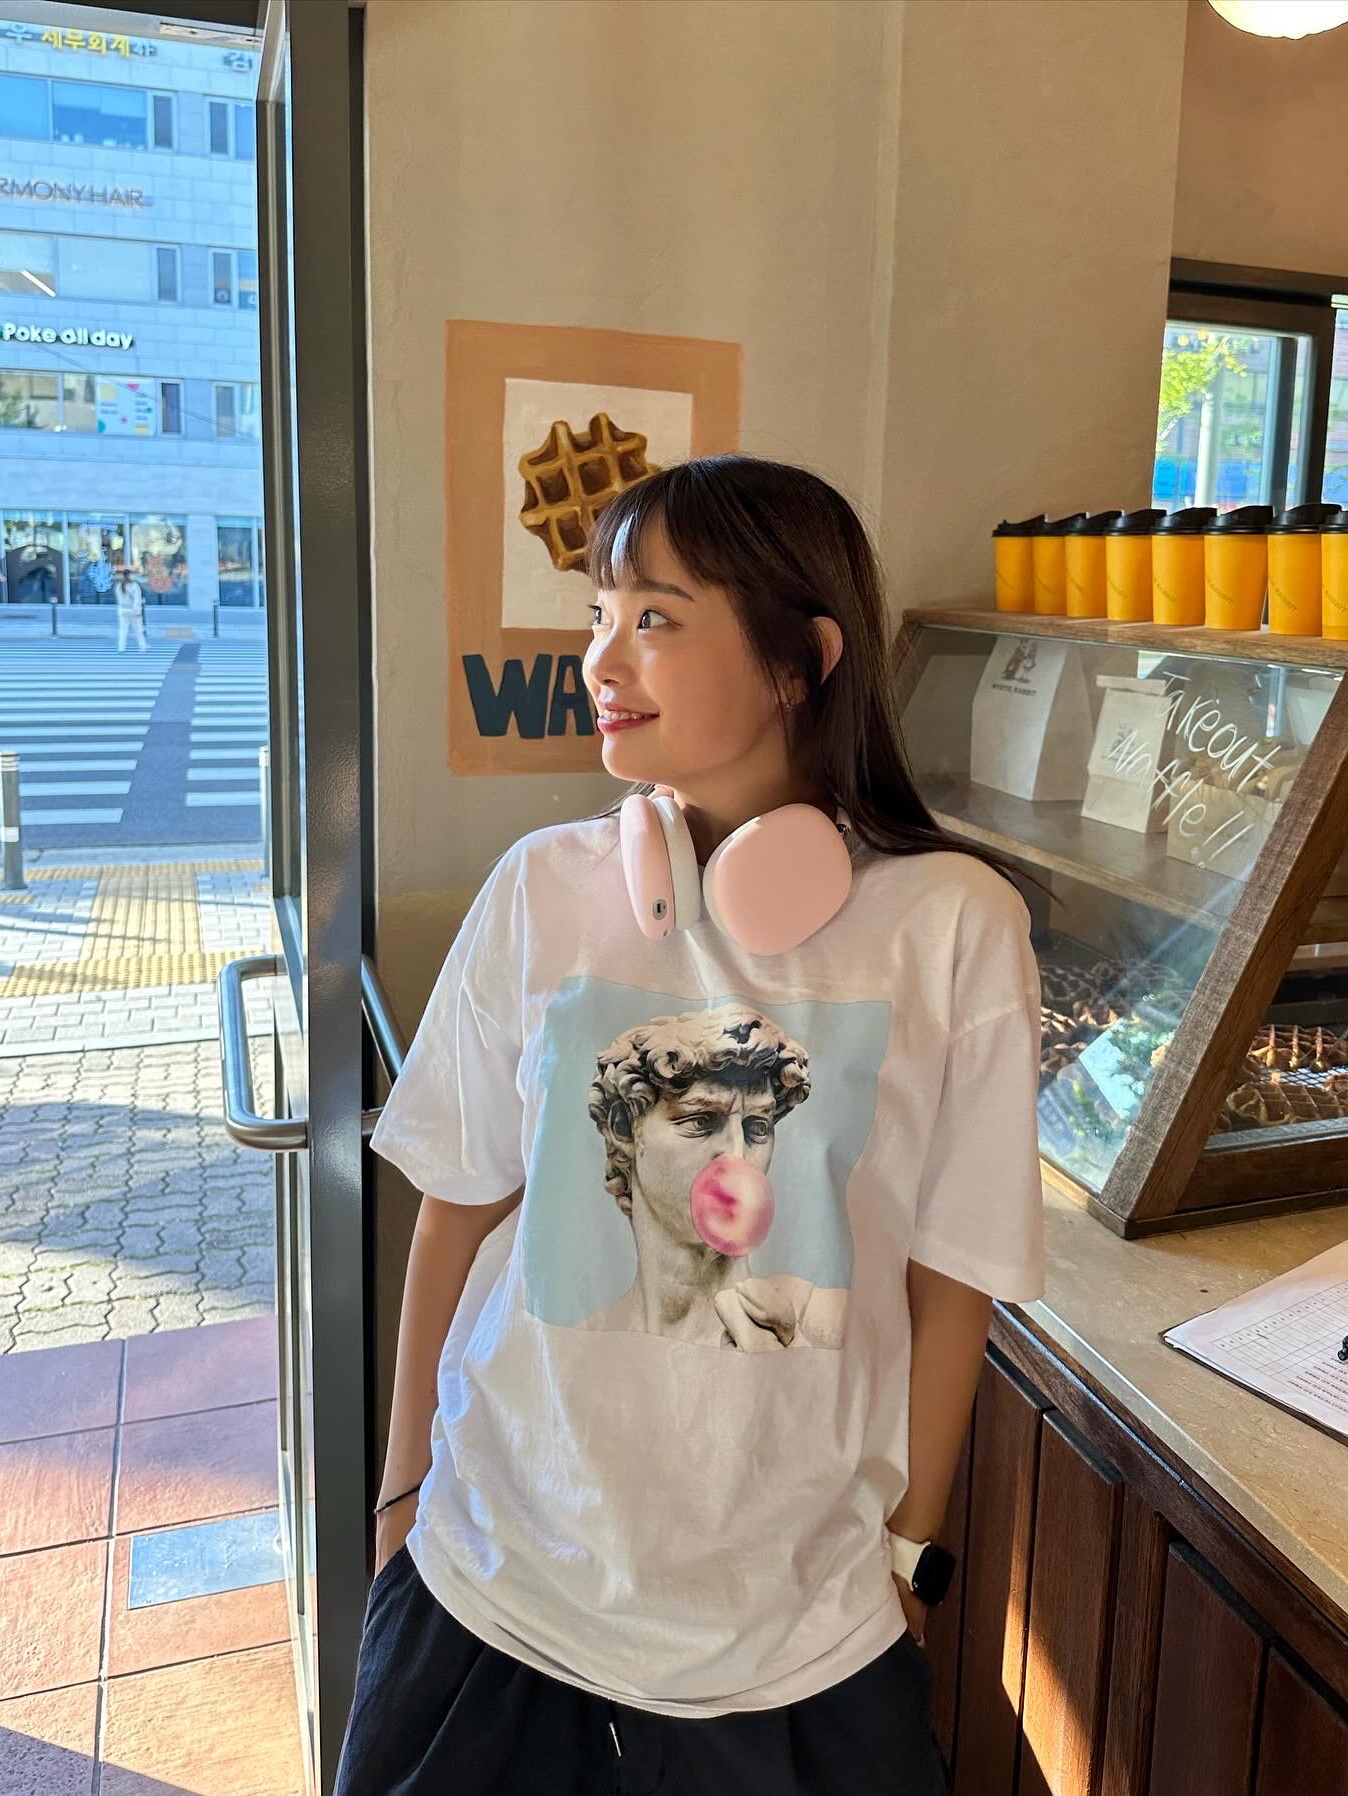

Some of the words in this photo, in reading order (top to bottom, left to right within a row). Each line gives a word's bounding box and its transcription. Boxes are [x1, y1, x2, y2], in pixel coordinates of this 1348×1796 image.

[41, 26, 131, 58] 세무회계
[90, 184, 146, 208] HAIR
[2, 321, 57, 344] Poke
[90, 329, 134, 351] day
[462, 654, 598, 739] WA
